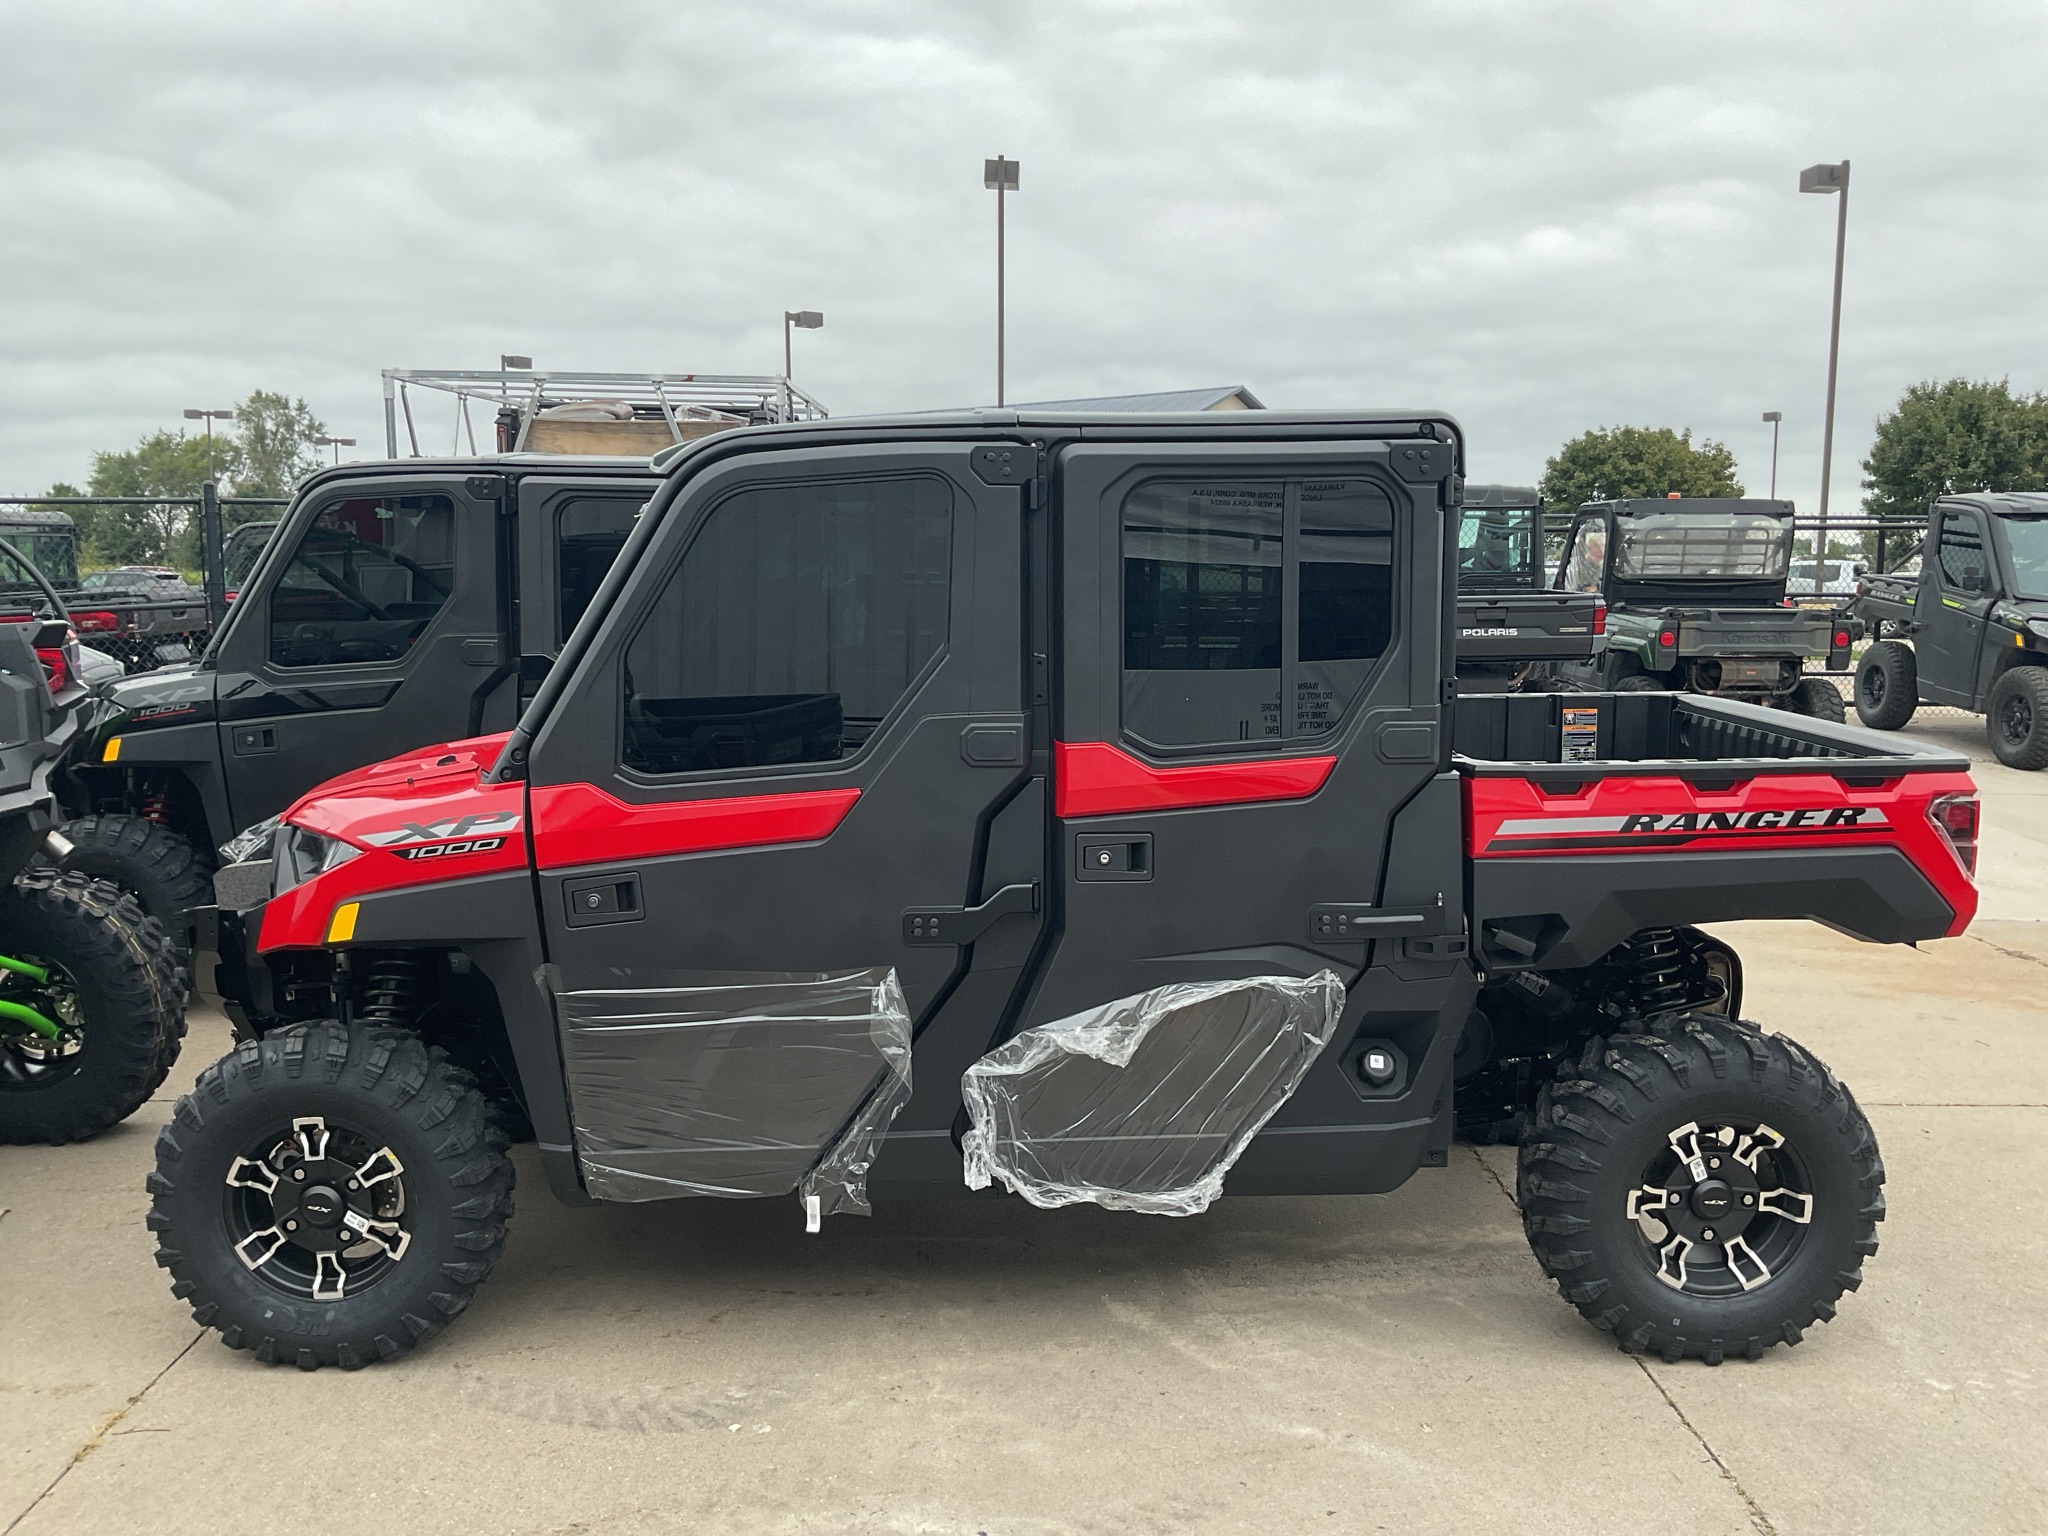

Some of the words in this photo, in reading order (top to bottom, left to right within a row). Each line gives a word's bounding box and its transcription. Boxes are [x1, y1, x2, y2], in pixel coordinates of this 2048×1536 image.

[1870, 590, 1901, 601] RANGER
[1992, 608, 2023, 620] XP
[1462, 628, 1519, 637] POLARIS
[132, 685, 207, 708] XP
[139, 703, 191, 717] 1000
[382, 810, 516, 846] XP
[1618, 807, 1867, 834] RANGER
[408, 838, 501, 860] 1000
